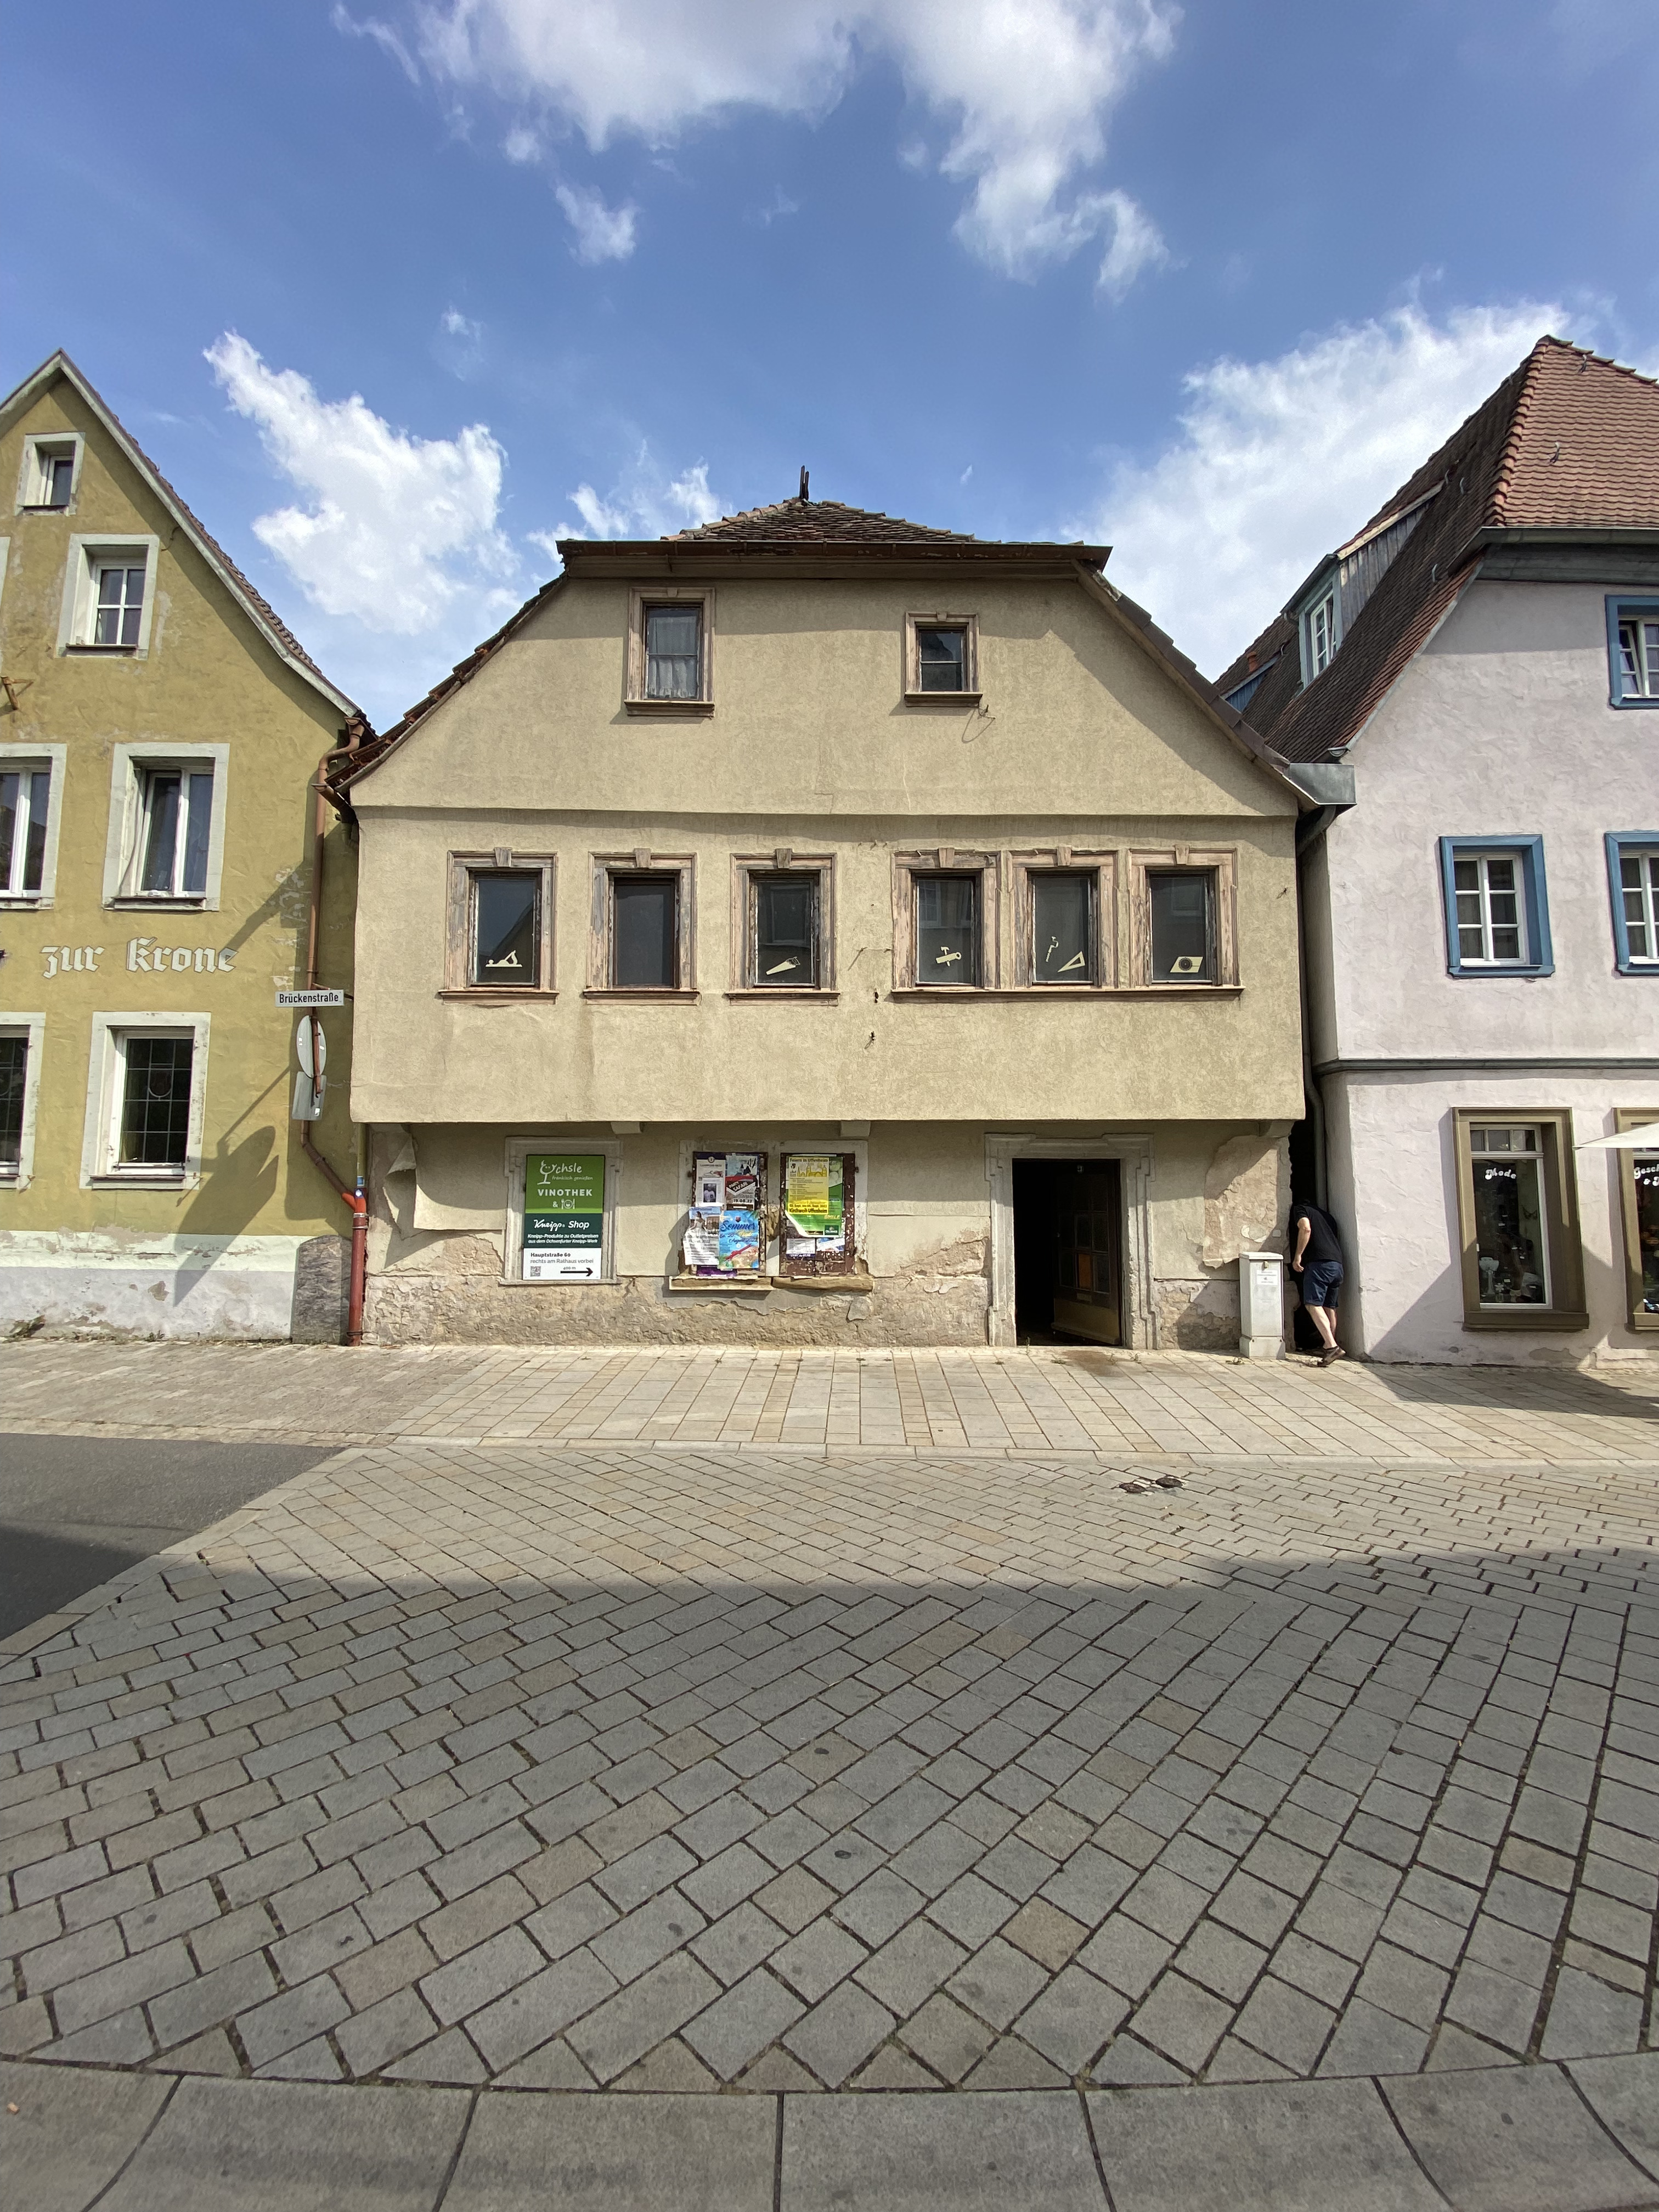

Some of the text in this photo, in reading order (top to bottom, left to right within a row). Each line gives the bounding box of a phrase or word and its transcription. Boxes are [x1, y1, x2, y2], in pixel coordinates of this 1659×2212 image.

[126, 936, 239, 973] Krone
[279, 992, 338, 1003] Brückenstraße
[1485, 1167, 1516, 1180] Mode
[568, 1221, 590, 1230] Shop
[720, 1220, 755, 1232] Sommer
